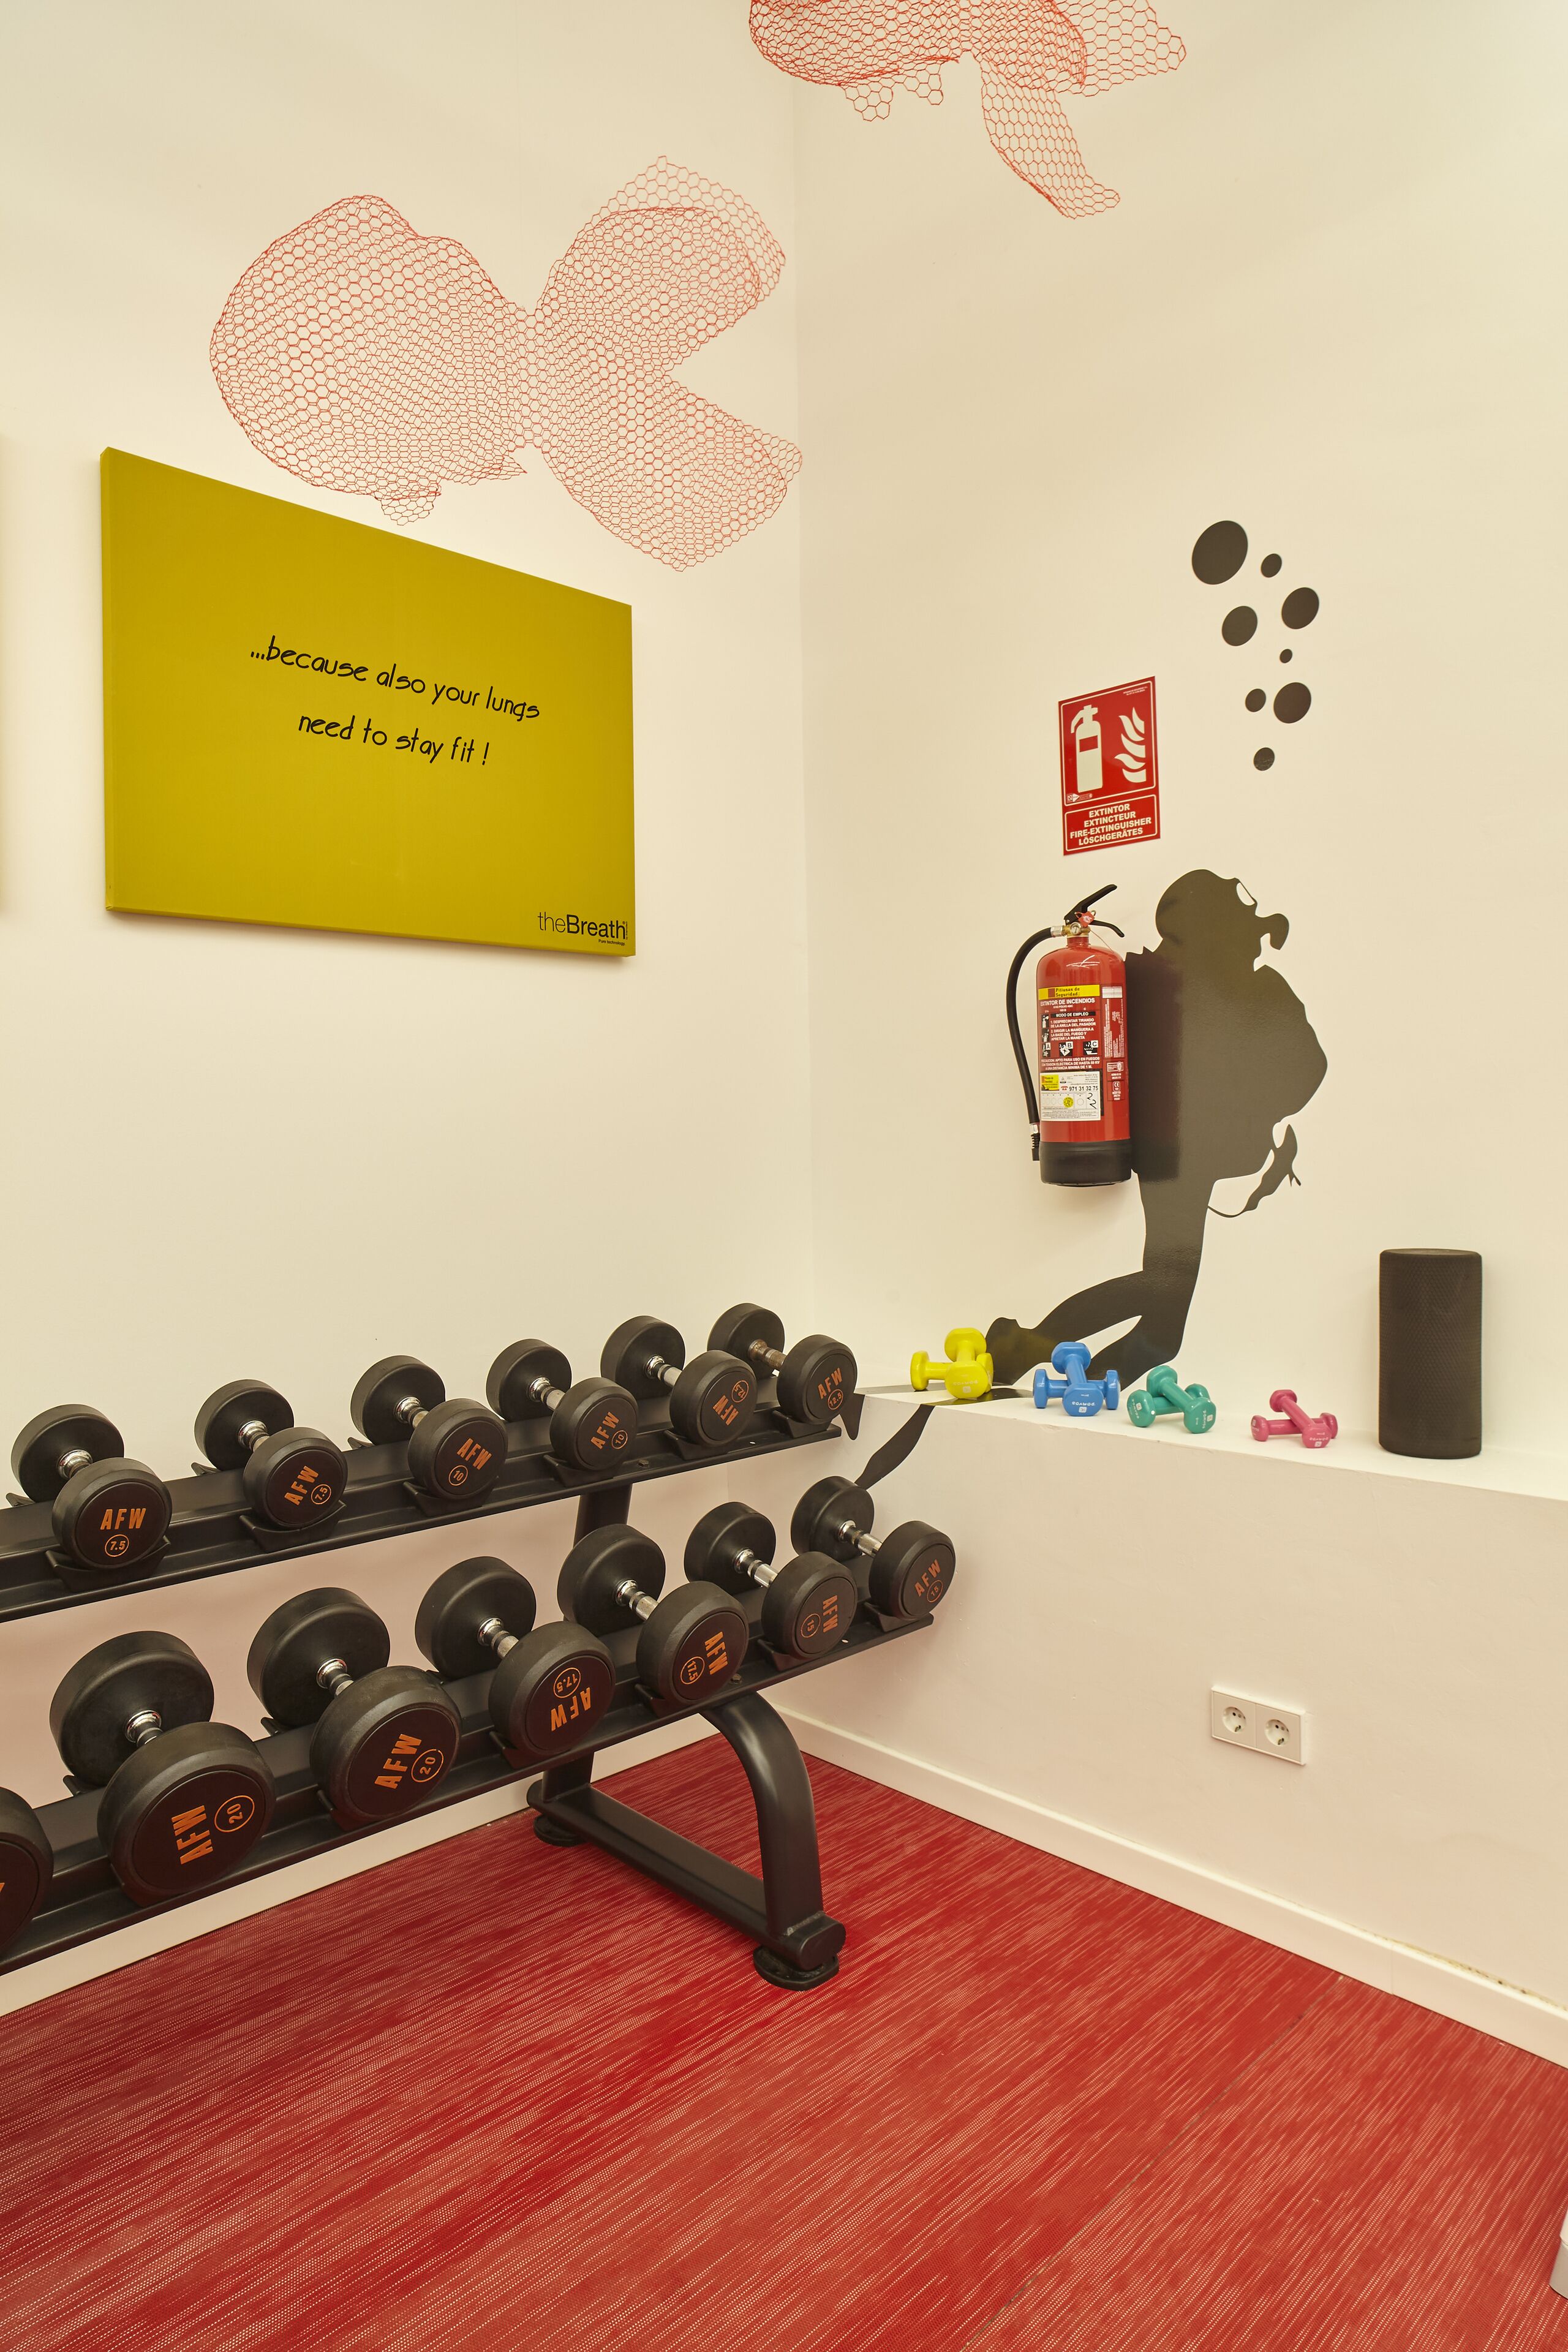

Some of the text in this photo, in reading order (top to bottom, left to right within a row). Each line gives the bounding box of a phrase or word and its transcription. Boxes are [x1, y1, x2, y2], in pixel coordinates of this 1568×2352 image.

[251, 635, 540, 722] ...because also your lungs
[298, 715, 355, 740] need
[363, 718, 388, 746] to
[395, 728, 444, 764] stay
[451, 736, 475, 763] fit
[1084, 811, 1136, 827] EXTINCTEUR
[1088, 803, 1130, 818] EXTINTOR
[1070, 816, 1152, 839] FIRE-EXTINGUISHER
[1079, 827, 1144, 846] LÖSCHGERÄTES
[817, 1367, 843, 1400] AFW
[712, 1394, 739, 1426] AFW
[829, 1392, 842, 1406] 12.5
[590, 1412, 619, 1450] AFW
[615, 1434, 624, 1444] 10
[456, 1437, 492, 1471] AFW
[284, 1465, 320, 1506] AFW
[453, 1471, 465, 1482] 10
[314, 1487, 329, 1501] 7.5
[100, 1508, 147, 1531] AFW
[110, 1540, 127, 1551] 7.5
[914, 1559, 941, 1597] AFW
[807, 1619, 815, 1632] 15
[823, 1595, 838, 1634] AFW
[704, 1631, 728, 1675] AFW
[687, 1660, 698, 1681] 17.5
[556, 1674, 579, 1693] 17.5
[551, 1687, 592, 1732] AFW
[374, 1733, 423, 1790] AFW
[419, 1756, 437, 1776] 20
[227, 1803, 244, 1825] 20
[171, 1804, 214, 1865] AFW
